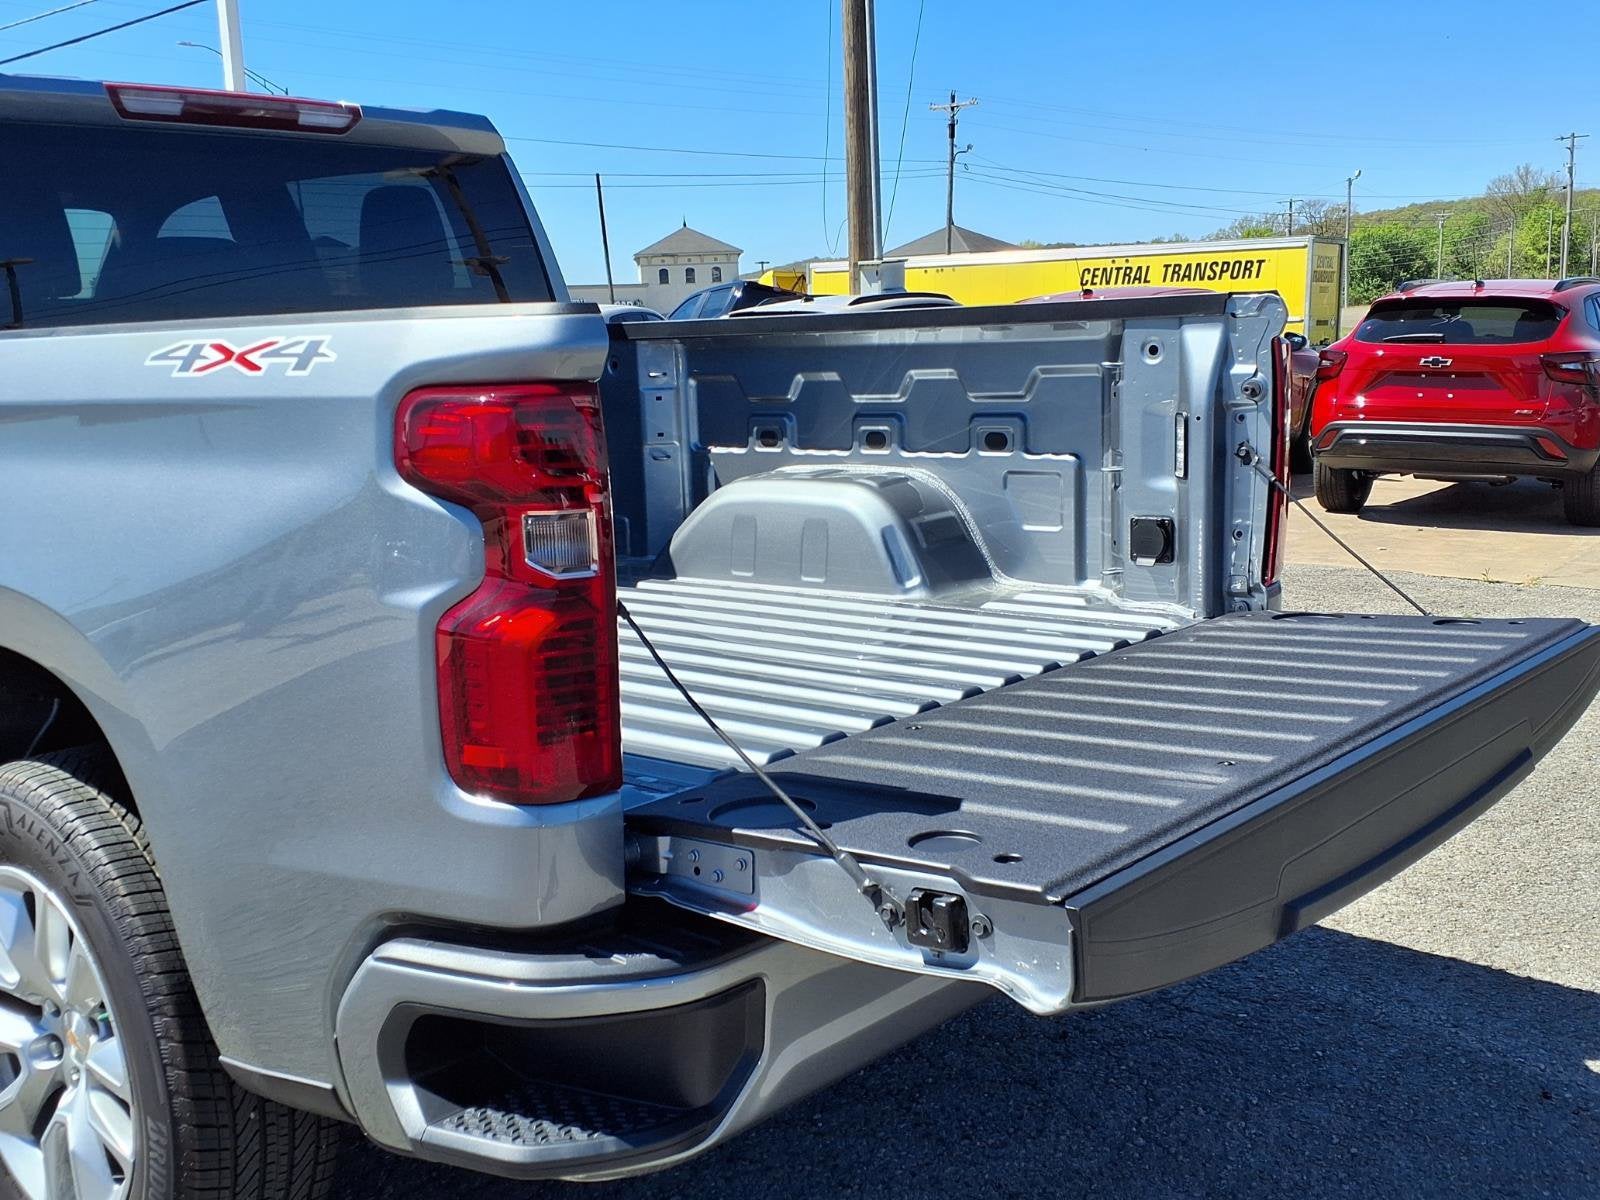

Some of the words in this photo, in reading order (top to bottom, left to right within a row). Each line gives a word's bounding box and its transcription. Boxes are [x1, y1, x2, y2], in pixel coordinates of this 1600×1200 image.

[1080, 264, 1151, 286] CENTRAL
[1162, 259, 1265, 283] TRANSPORT
[16, 813, 80, 887] ALENZA
